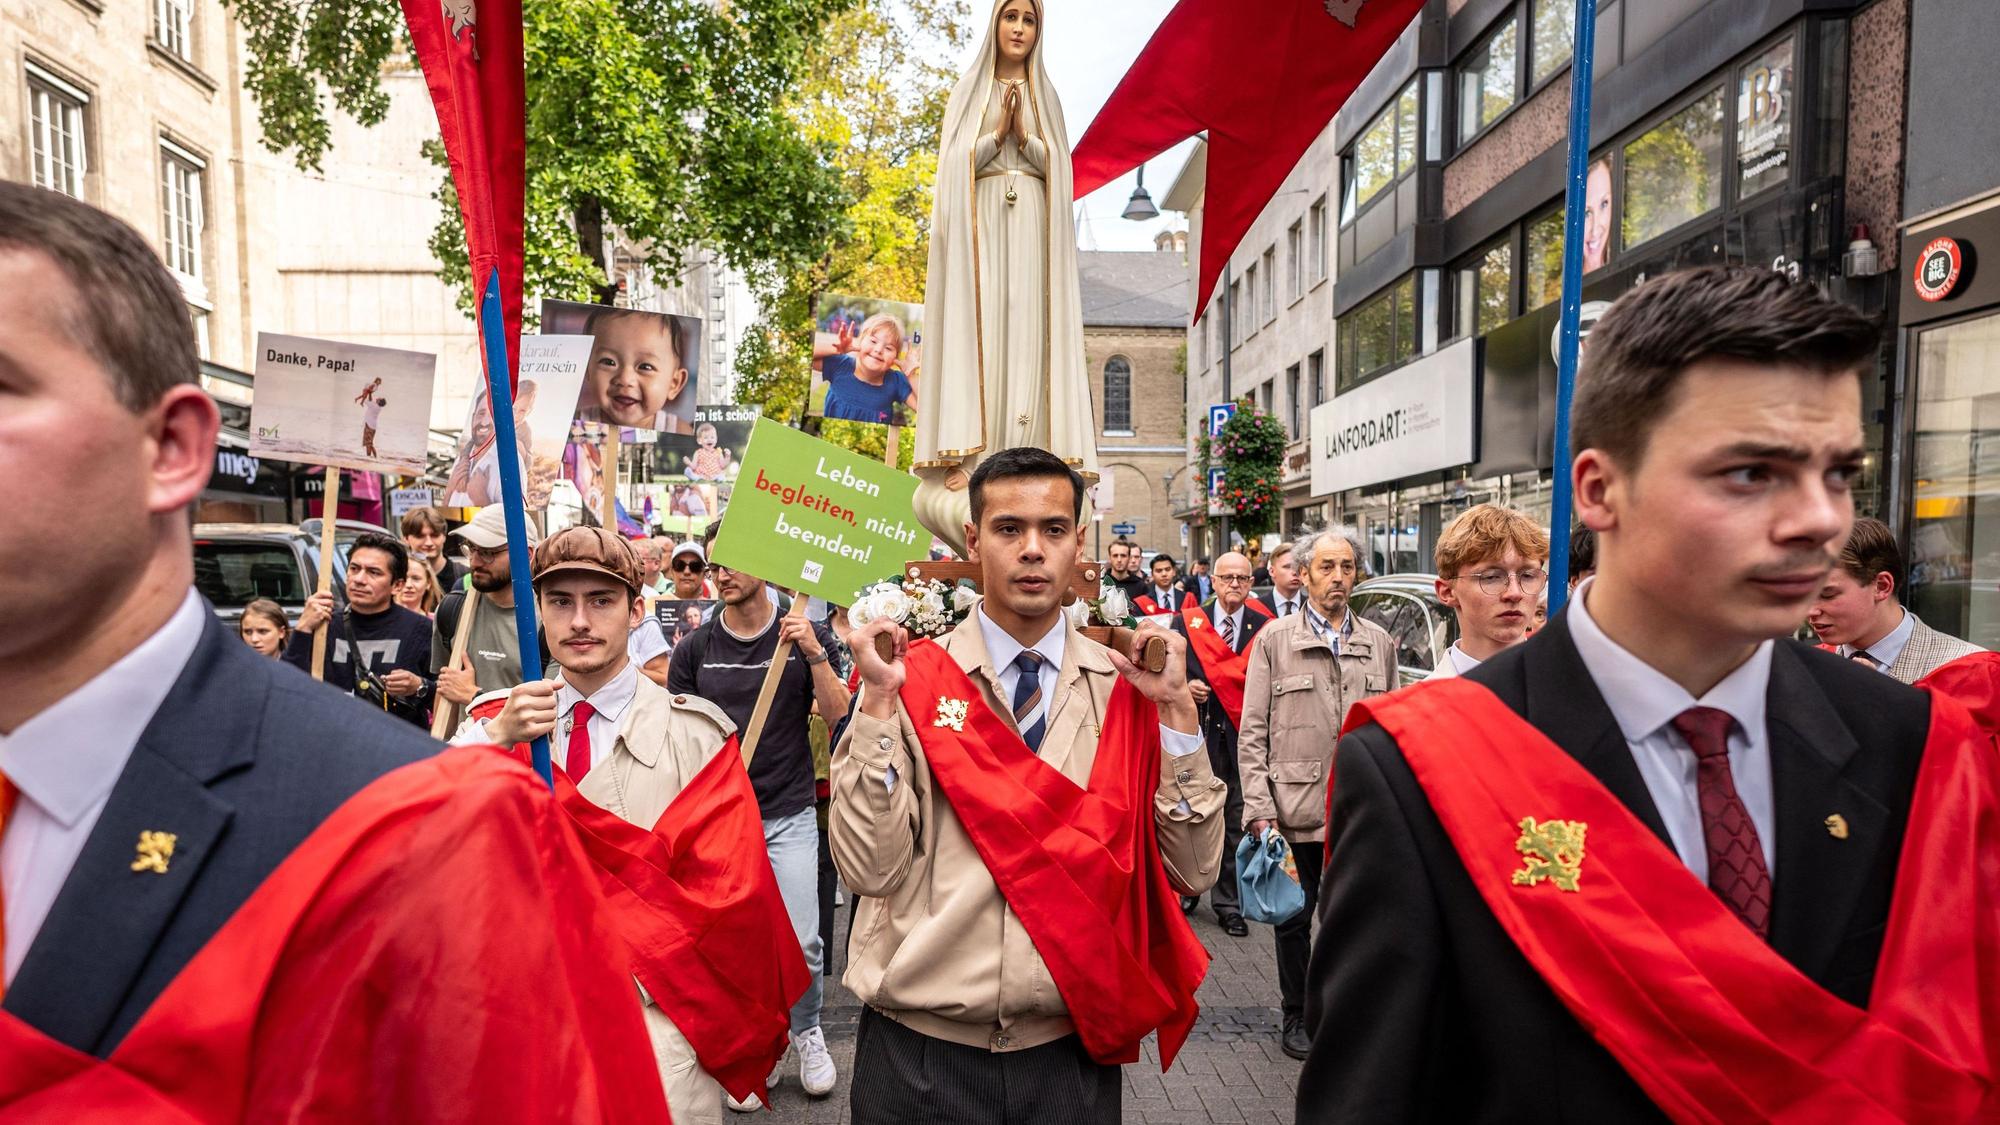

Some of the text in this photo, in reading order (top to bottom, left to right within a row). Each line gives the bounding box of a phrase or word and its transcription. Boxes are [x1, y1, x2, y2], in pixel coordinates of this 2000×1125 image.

[1928, 256, 1945, 271] SEE
[266, 349, 355, 372] Danke, Papa!
[535, 362, 550, 373] zu
[550, 360, 577, 373] sein
[708, 409, 723, 421] ist
[1213, 408, 1228, 436] P
[218, 452, 259, 484] mey
[816, 457, 880, 497] Leben
[755, 469, 916, 545] begleiten, nicht
[774, 512, 873, 564] beenden!
